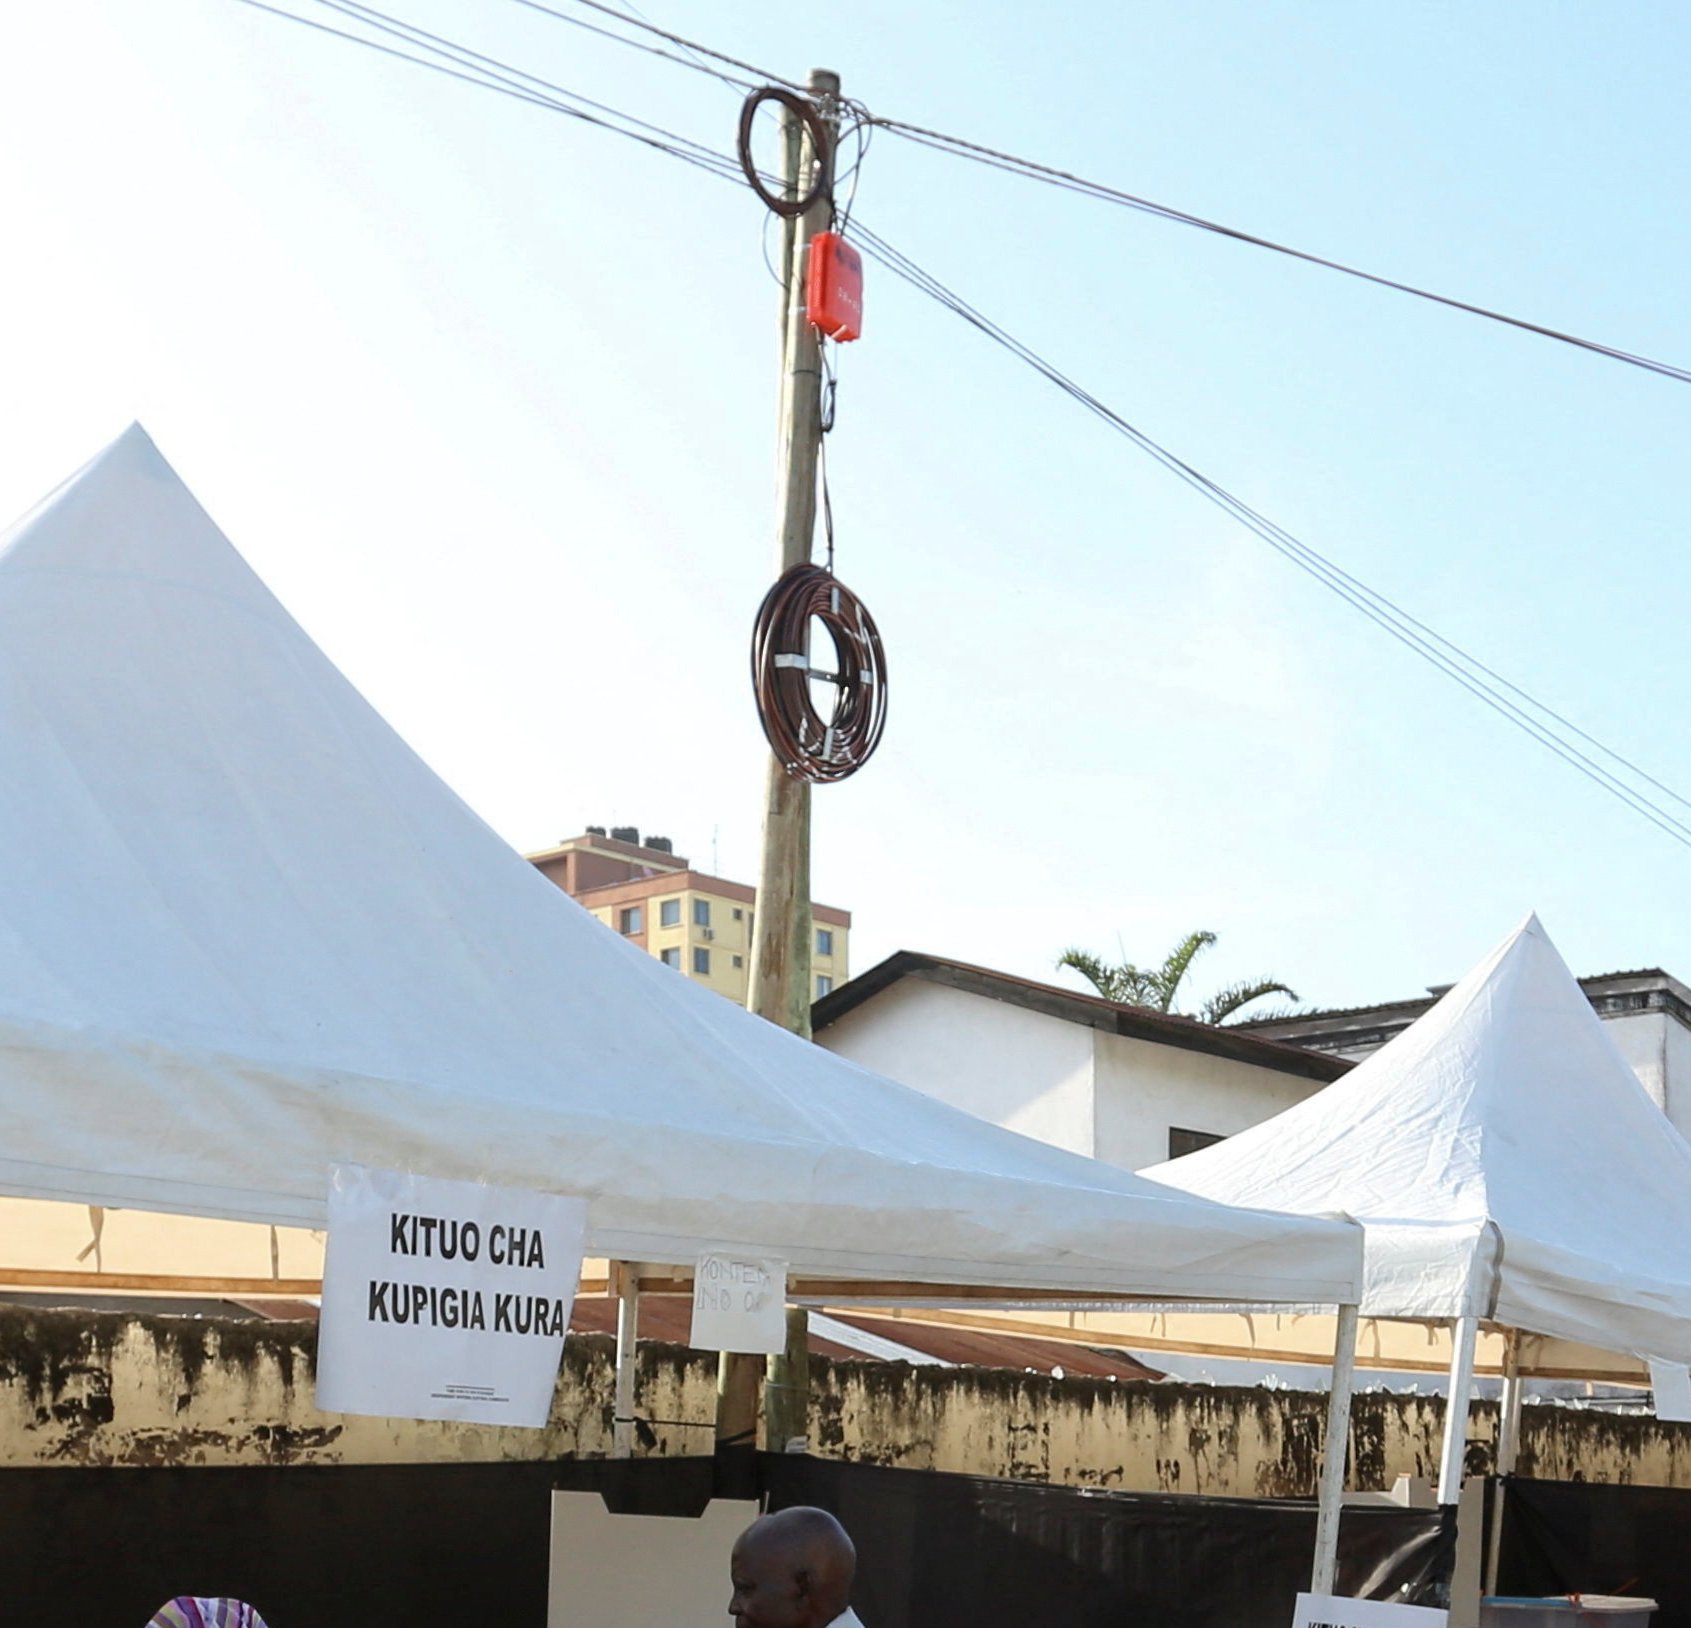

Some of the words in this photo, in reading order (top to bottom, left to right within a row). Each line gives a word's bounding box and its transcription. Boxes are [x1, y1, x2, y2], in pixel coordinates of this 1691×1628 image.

[391, 1212, 480, 1262] KITUO
[488, 1224, 545, 1269] CHA
[368, 1280, 486, 1331] KUPIGIA
[494, 1292, 565, 1338] KURA
